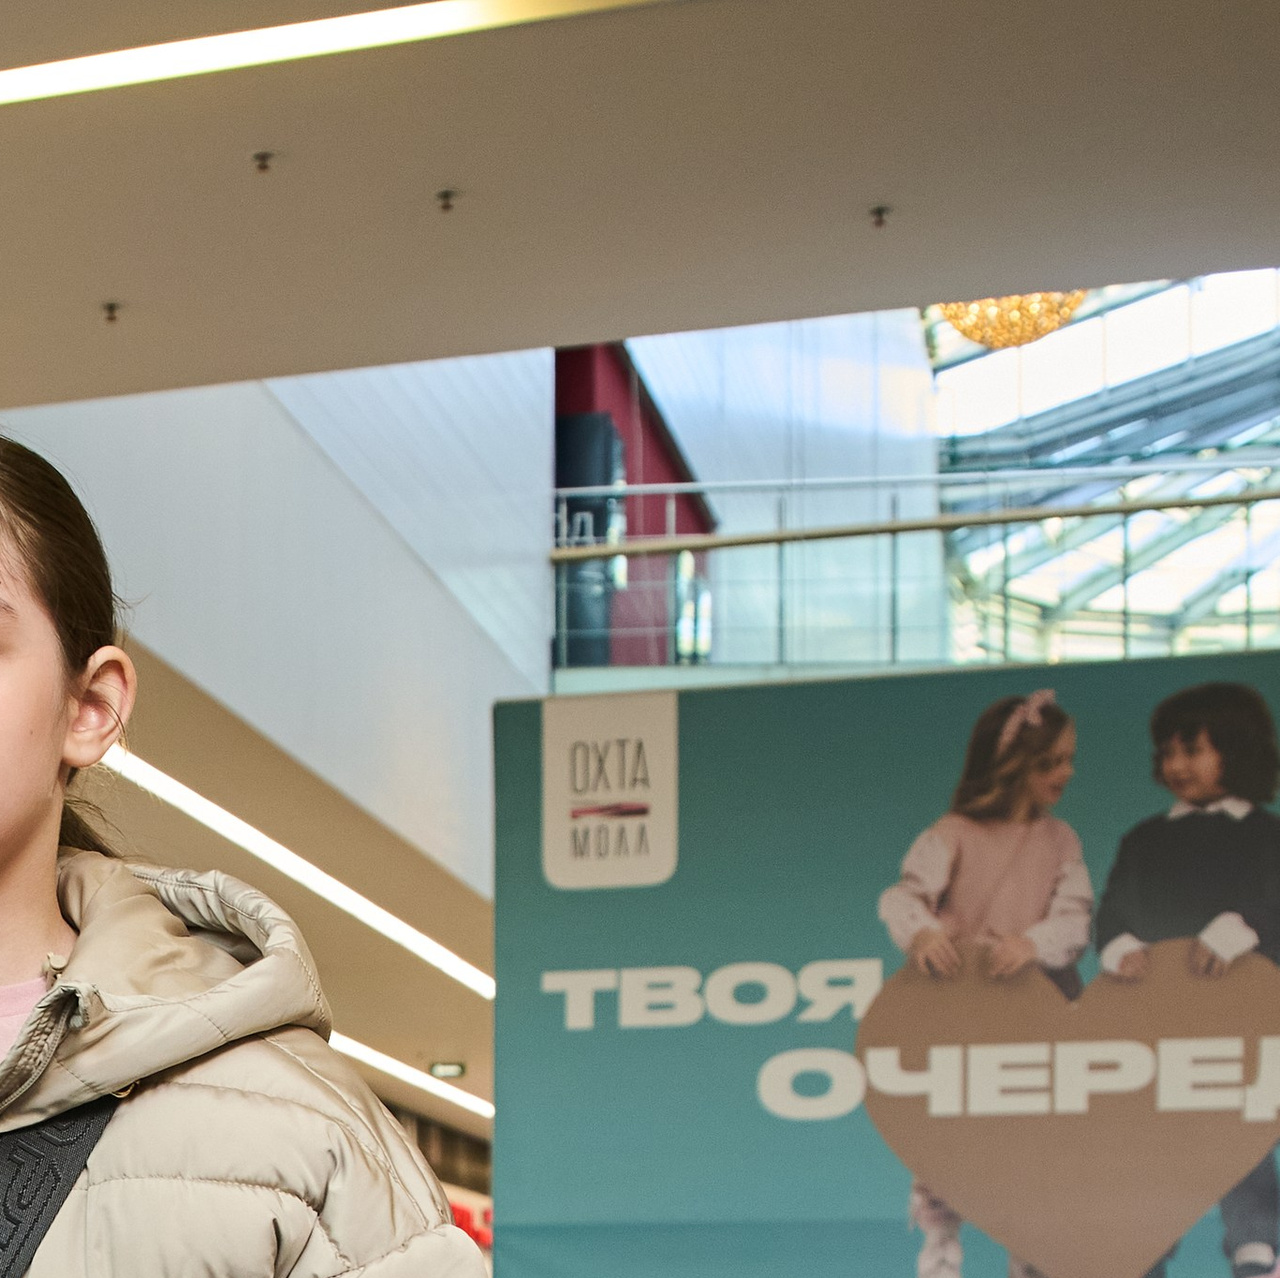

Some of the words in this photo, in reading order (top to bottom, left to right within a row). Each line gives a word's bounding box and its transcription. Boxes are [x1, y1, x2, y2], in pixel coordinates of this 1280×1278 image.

[570, 737, 651, 795] ОХТА
[571, 823, 650, 861] МОЛЛ
[540, 957, 885, 1032] ТВОЯ
